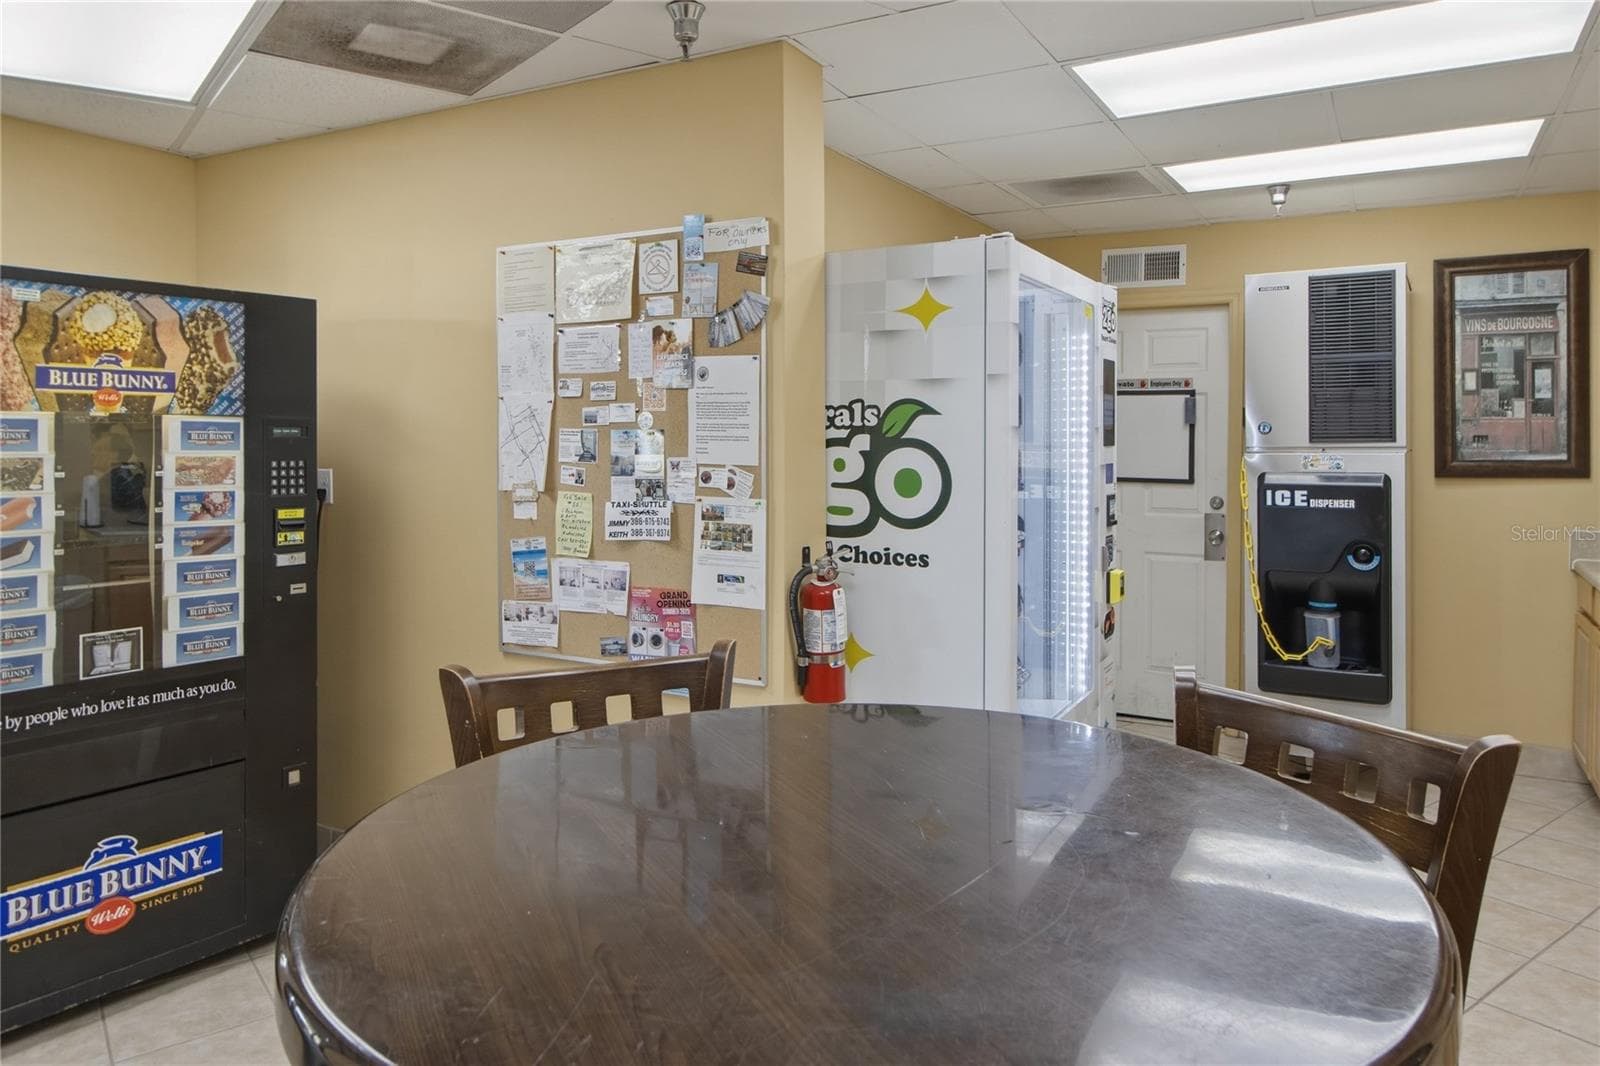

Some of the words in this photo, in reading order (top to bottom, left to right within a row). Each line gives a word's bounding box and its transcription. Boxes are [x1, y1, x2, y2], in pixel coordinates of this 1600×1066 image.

[707, 227, 730, 237] FOR
[1465, 318, 1487, 332] VINS
[1498, 315, 1553, 331] BOURGOGNE
[48, 368, 98, 387] BLUE
[101, 371, 164, 389] BUNNY
[1266, 489, 1308, 507] ICE
[1309, 498, 1355, 509] DISPENSER
[608, 519, 630, 527] JIMMY
[836, 544, 929, 568] Choices
[0, 589, 27, 599] UNNY
[656, 599, 692, 608] OPENING
[660, 591, 688, 599] GRAND
[5, 716, 22, 731] by
[25, 706, 69, 728] people
[71, 701, 98, 718] who
[100, 698, 125, 714] love
[126, 695, 136, 708] it
[137, 694, 150, 706] as
[152, 686, 185, 704] much
[186, 686, 199, 698] as
[199, 683, 221, 701] you
[220, 678, 237, 692] do.
[6, 878, 94, 928] BLUE
[99, 845, 207, 899] BUNNY
[9, 923, 80, 952] QUALITY
[141, 892, 179, 911] SINCE
[182, 884, 204, 898] 1913
[90, 904, 130, 926] Wells
